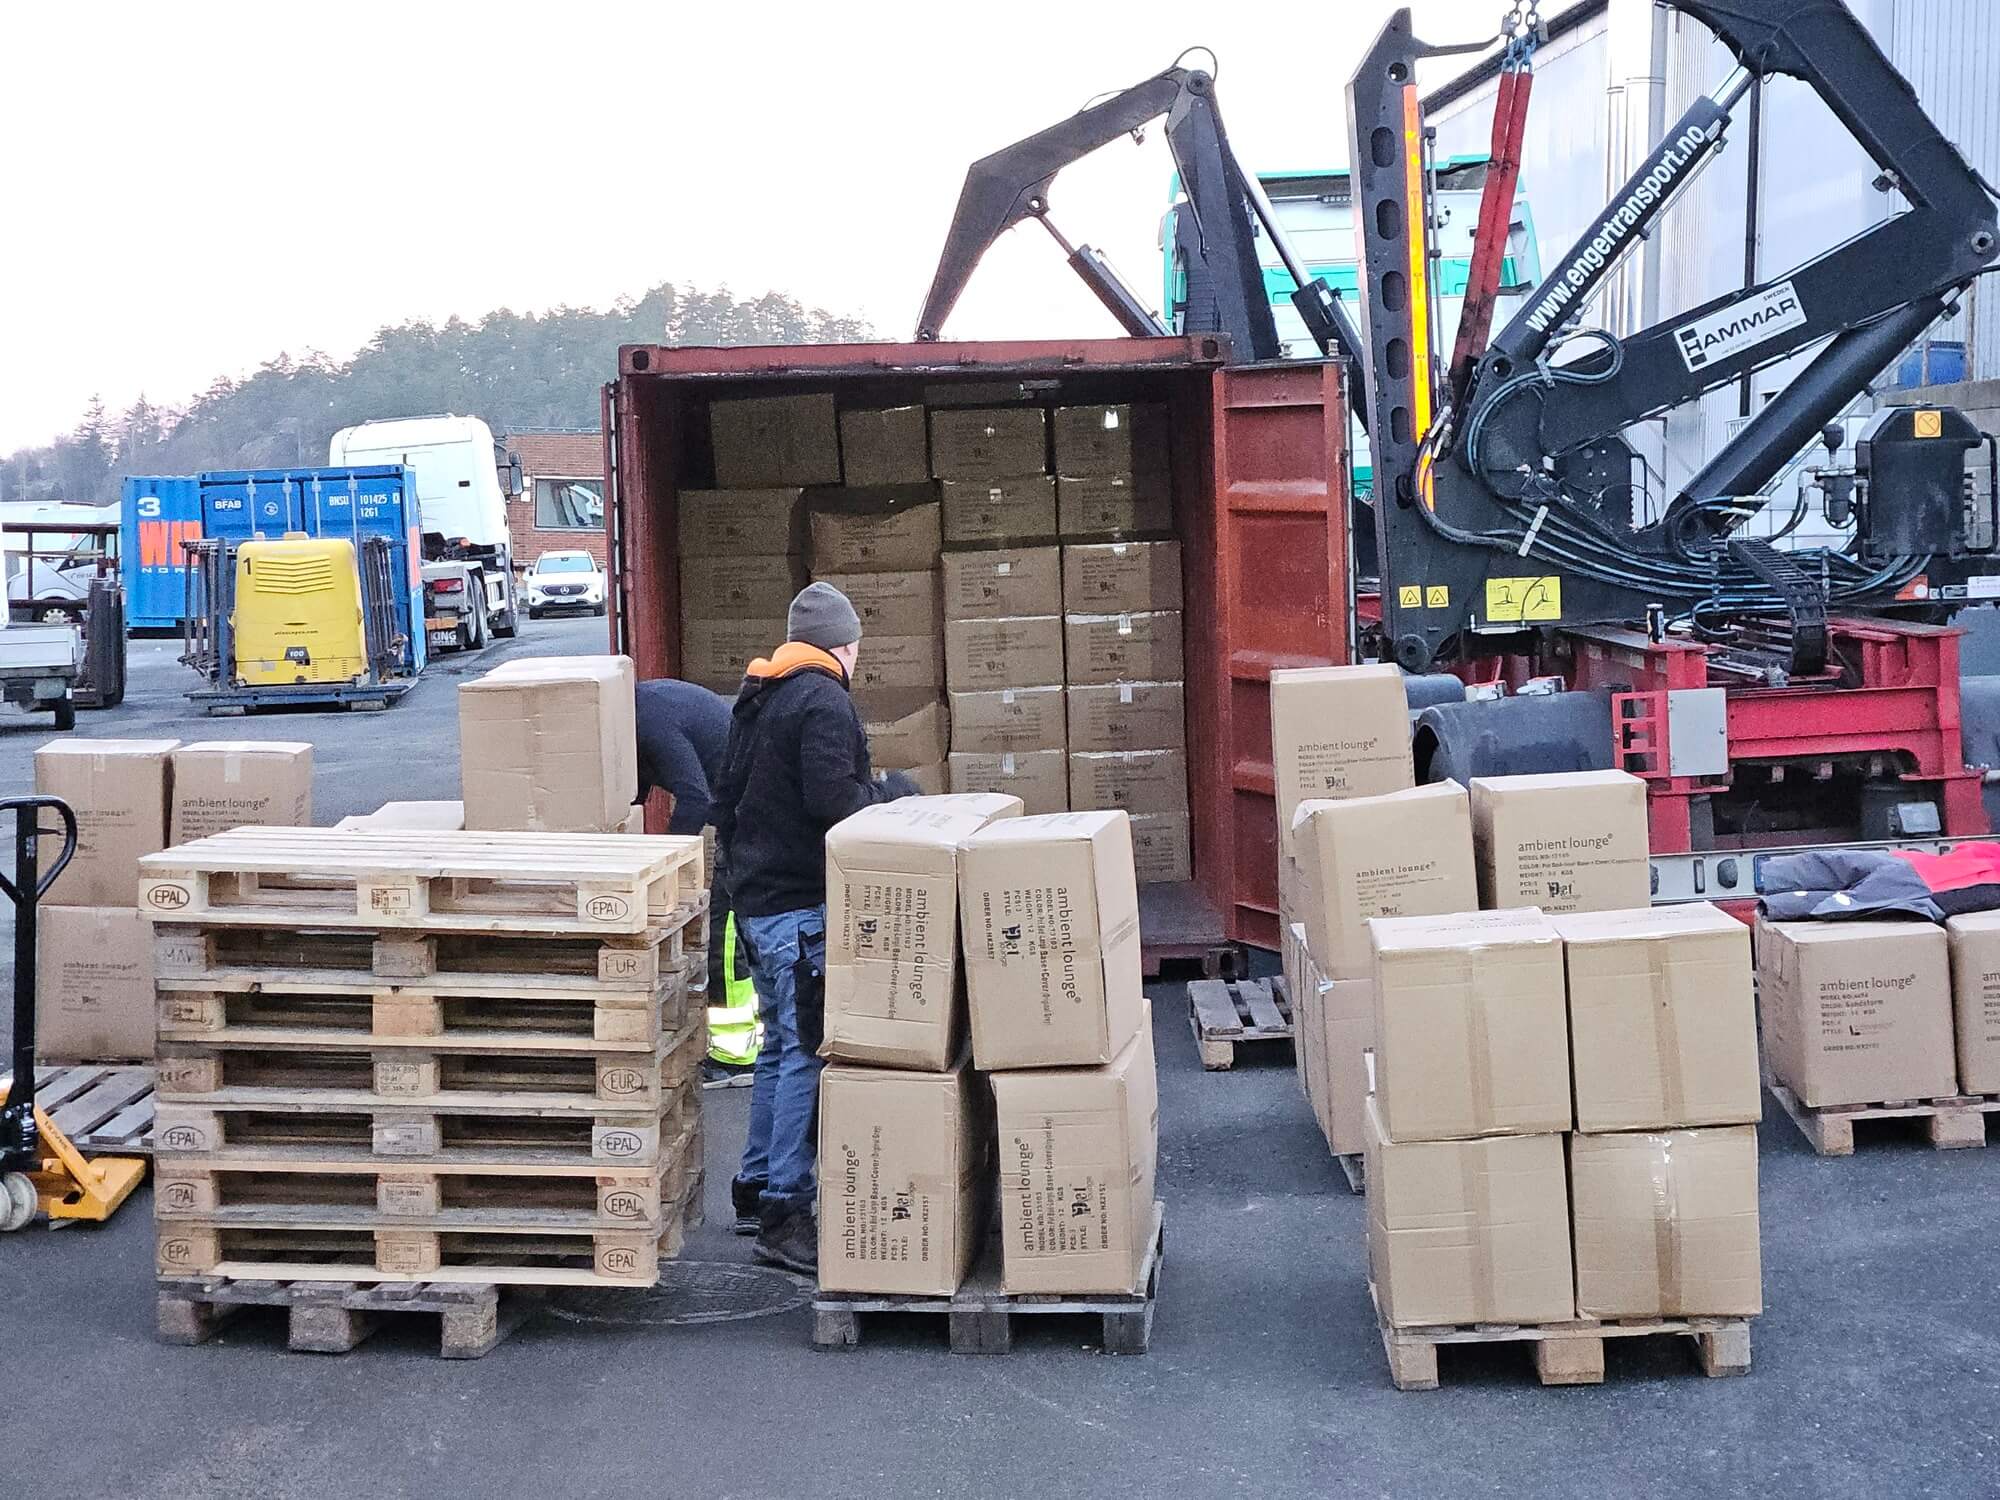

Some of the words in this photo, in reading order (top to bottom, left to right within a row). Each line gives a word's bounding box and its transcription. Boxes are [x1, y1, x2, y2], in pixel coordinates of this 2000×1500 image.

[1525, 124, 1707, 333] www.engertransport.no
[1763, 286, 1791, 302] SWEDEN
[1683, 297, 1798, 357] HAMMAR
[138, 497, 161, 516] 3
[215, 500, 241, 509] BFAB
[243, 557, 252, 575] 1
[1298, 741, 1340, 752] ambient
[182, 797, 227, 809] ambient
[1518, 839, 1567, 852] ambient
[1356, 867, 1395, 878] ambient
[154, 888, 184, 905] EPAL
[884, 887, 892, 916] WEIGHT:
[983, 892, 991, 917] ORDER
[1024, 889, 1032, 920] WEIGHT:
[1045, 888, 1053, 912] MODEL
[914, 888, 930, 948] ambient
[1057, 888, 1075, 947] ambient
[1820, 979, 1870, 991] ambient
[606, 1137, 635, 1151] EPAL
[611, 1198, 640, 1212] EPAL
[842, 1200, 856, 1259] ambient
[1020, 1193, 1034, 1251] ambient
[608, 1253, 635, 1268] EPAL
